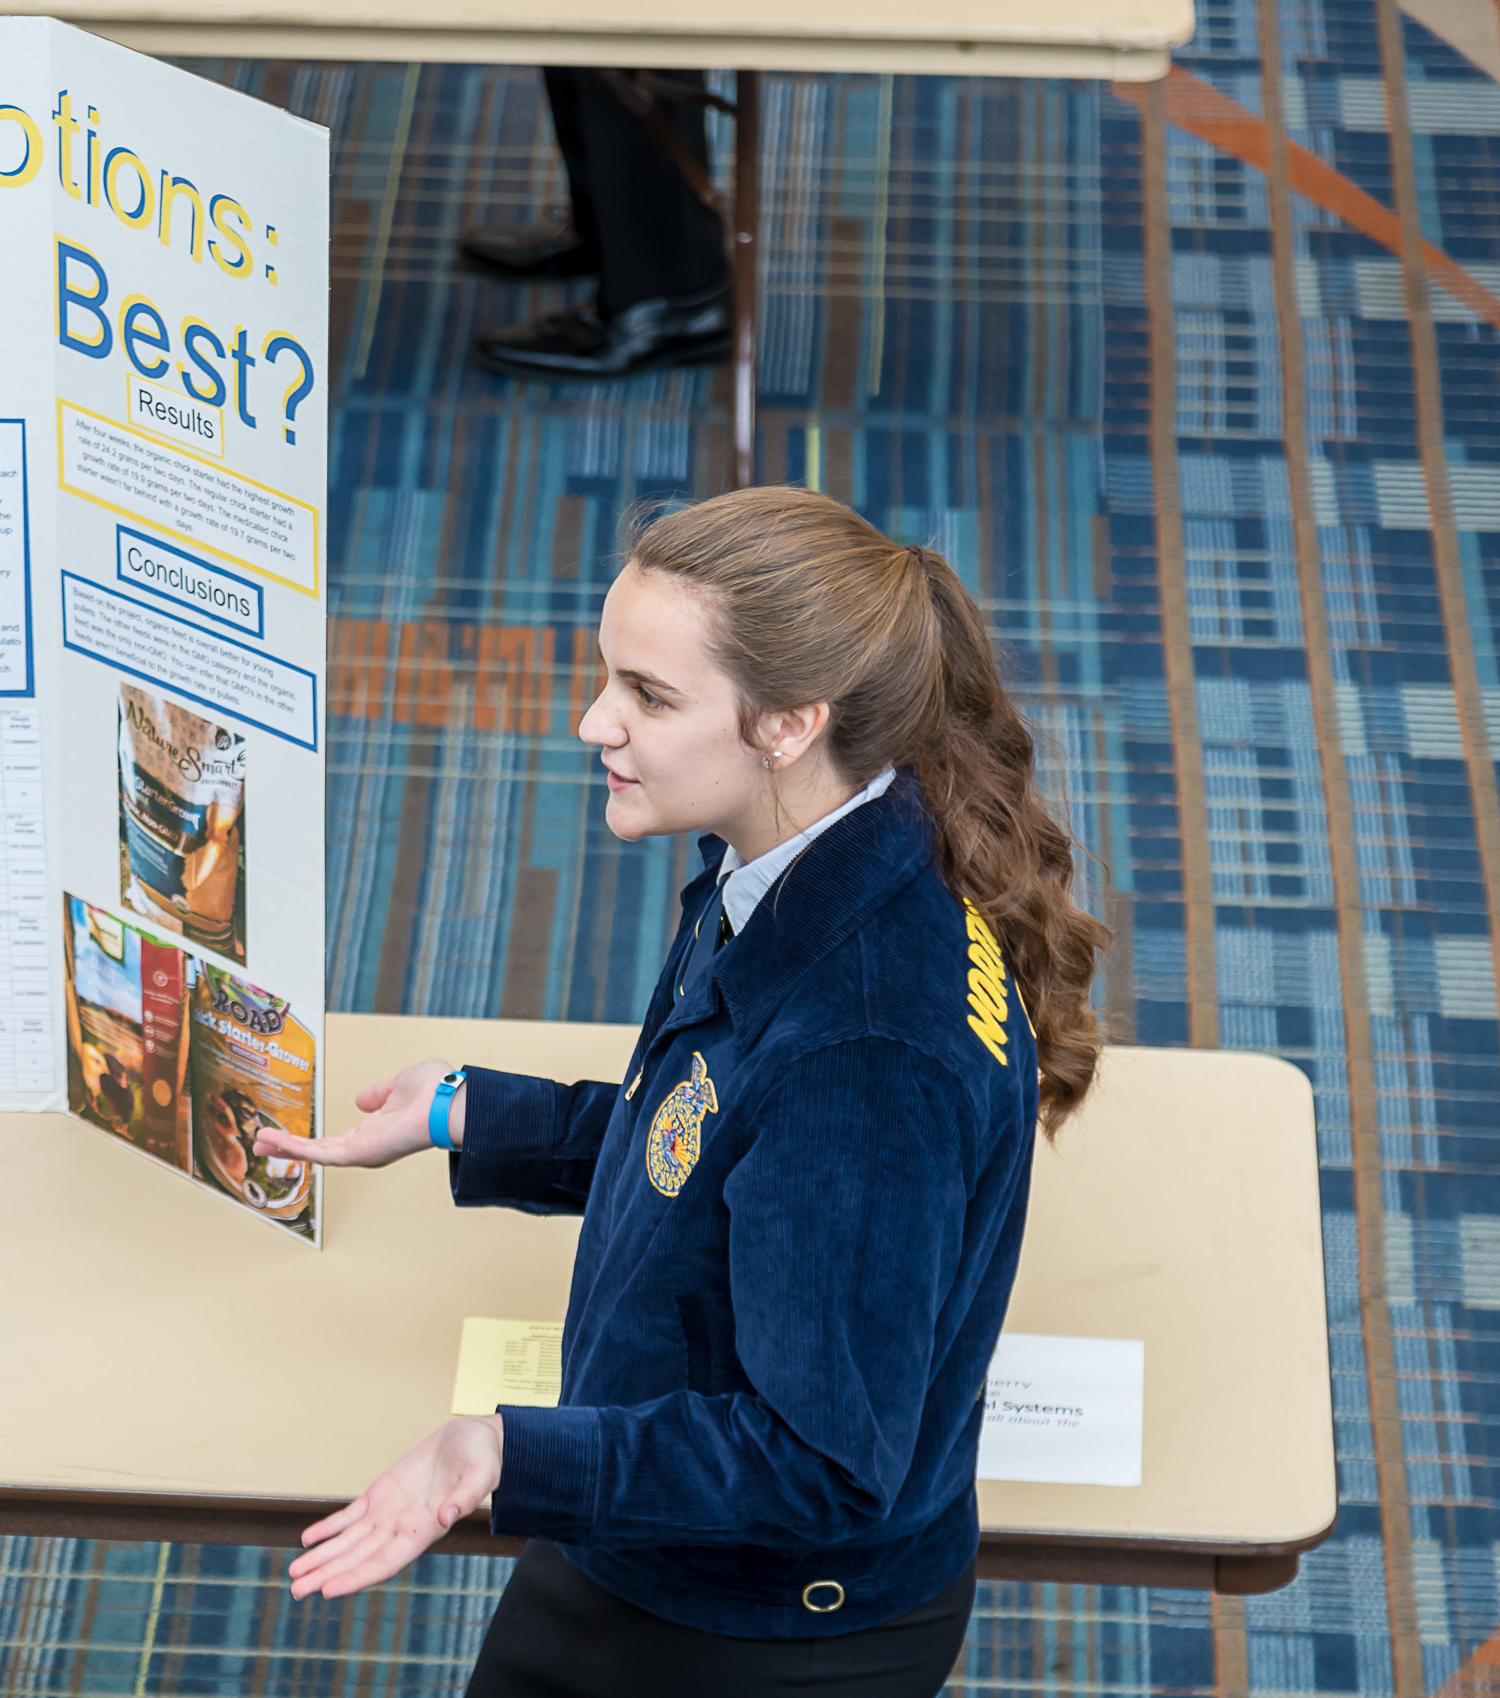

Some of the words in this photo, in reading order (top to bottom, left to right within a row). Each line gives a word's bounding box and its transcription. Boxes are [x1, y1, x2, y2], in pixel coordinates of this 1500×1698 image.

[53, 232, 315, 446] Best?
[139, 388, 215, 439] Results
[127, 547, 251, 618] Conclusions
[212, 989, 283, 1035] ROAD
[1002, 1401, 1084, 1417] Systems
[1008, 1416, 1050, 1427] about
[1057, 1418, 1081, 1428] the
